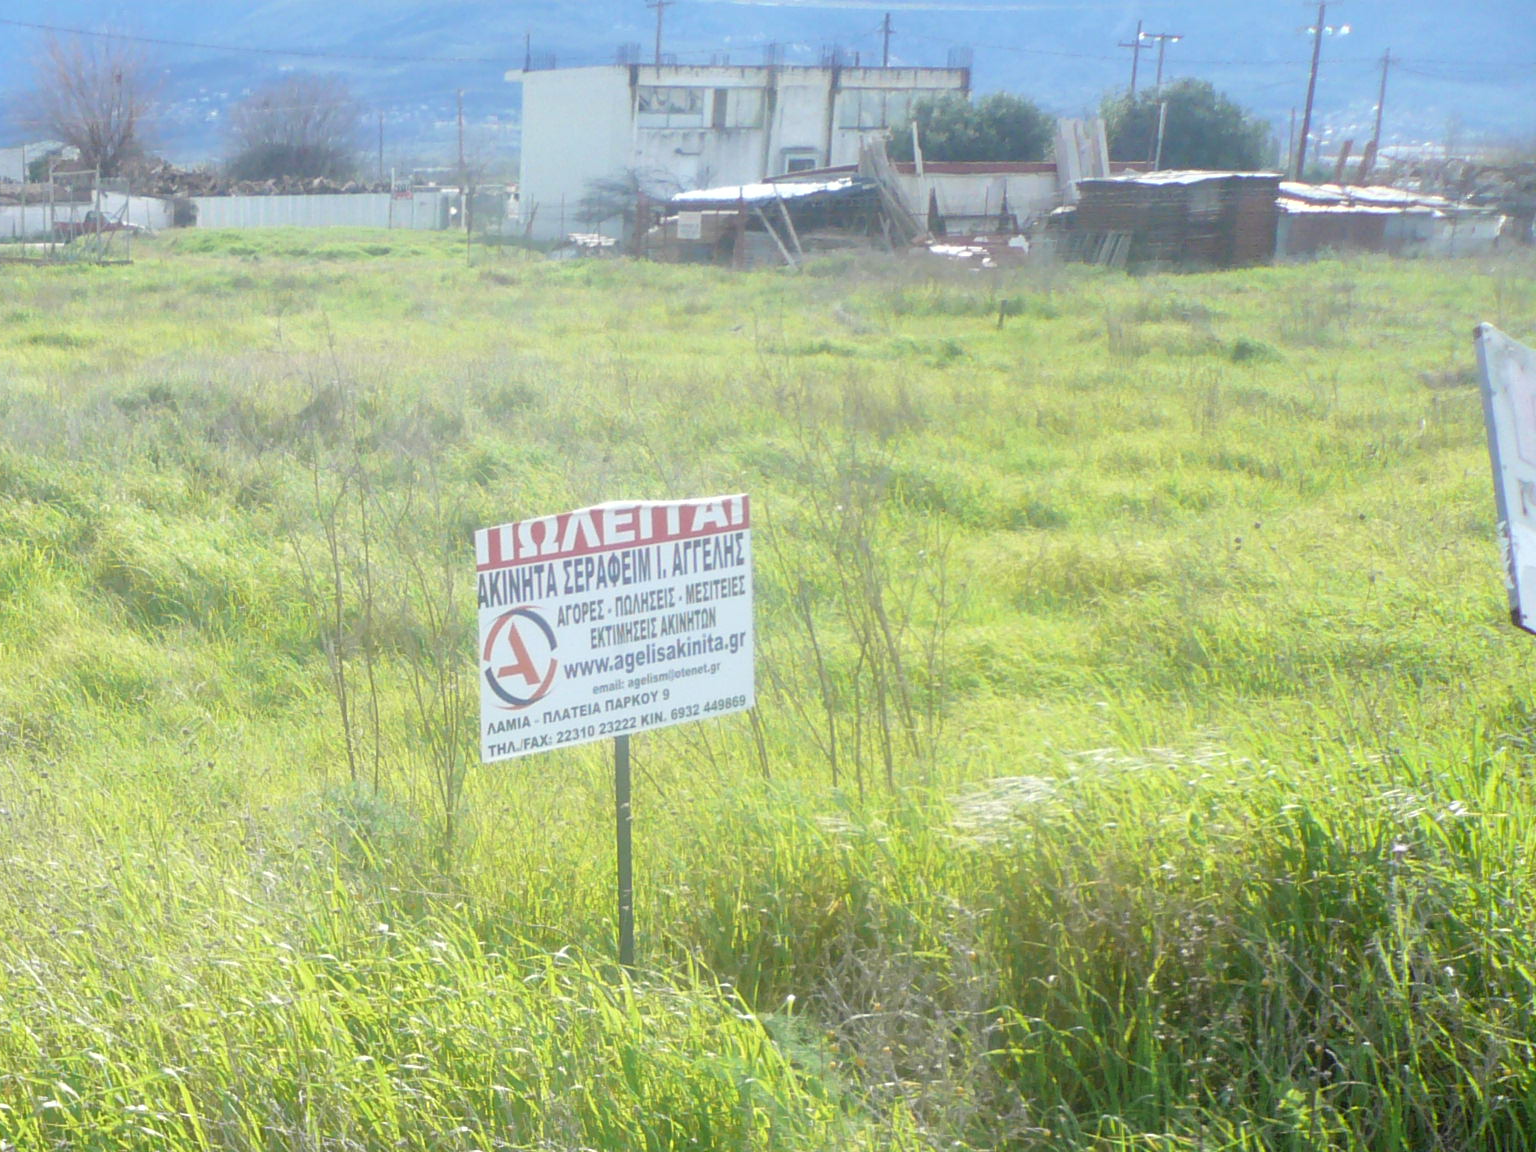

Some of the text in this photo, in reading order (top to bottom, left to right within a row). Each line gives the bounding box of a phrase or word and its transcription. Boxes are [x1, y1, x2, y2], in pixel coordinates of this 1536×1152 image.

[478, 563, 558, 609] ΑΚΙΝΗΤΑ
[563, 547, 651, 595] ΣΕΡΑΦΕΙΜ
[672, 532, 745, 577] ΑΓΓΕΛΗΣ
[557, 600, 605, 628] ΑΓΟΡΕΣ
[614, 587, 675, 618] ΠΩΛΗΣΕΙΣ
[686, 575, 746, 605] ΜΕΣΙΤΕΙΕΣ
[590, 606, 716, 650] ΕΚΤΙΜΗΣΕΙΣ ΑΚΙΝΗΤΩΝ
[564, 631, 746, 680] www.agelisakinita.gr
[592, 677, 625, 695] email:
[487, 715, 531, 736] ΛΑΜΙΑ
[543, 702, 601, 725] ΠΛΑΤΕΙΑ
[606, 690, 659, 712] ΠΑΡΚΟΥ
[663, 688, 670, 702] 9
[557, 724, 595, 744] 22310
[599, 717, 637, 735] 23222
[671, 704, 700, 721] 6932
